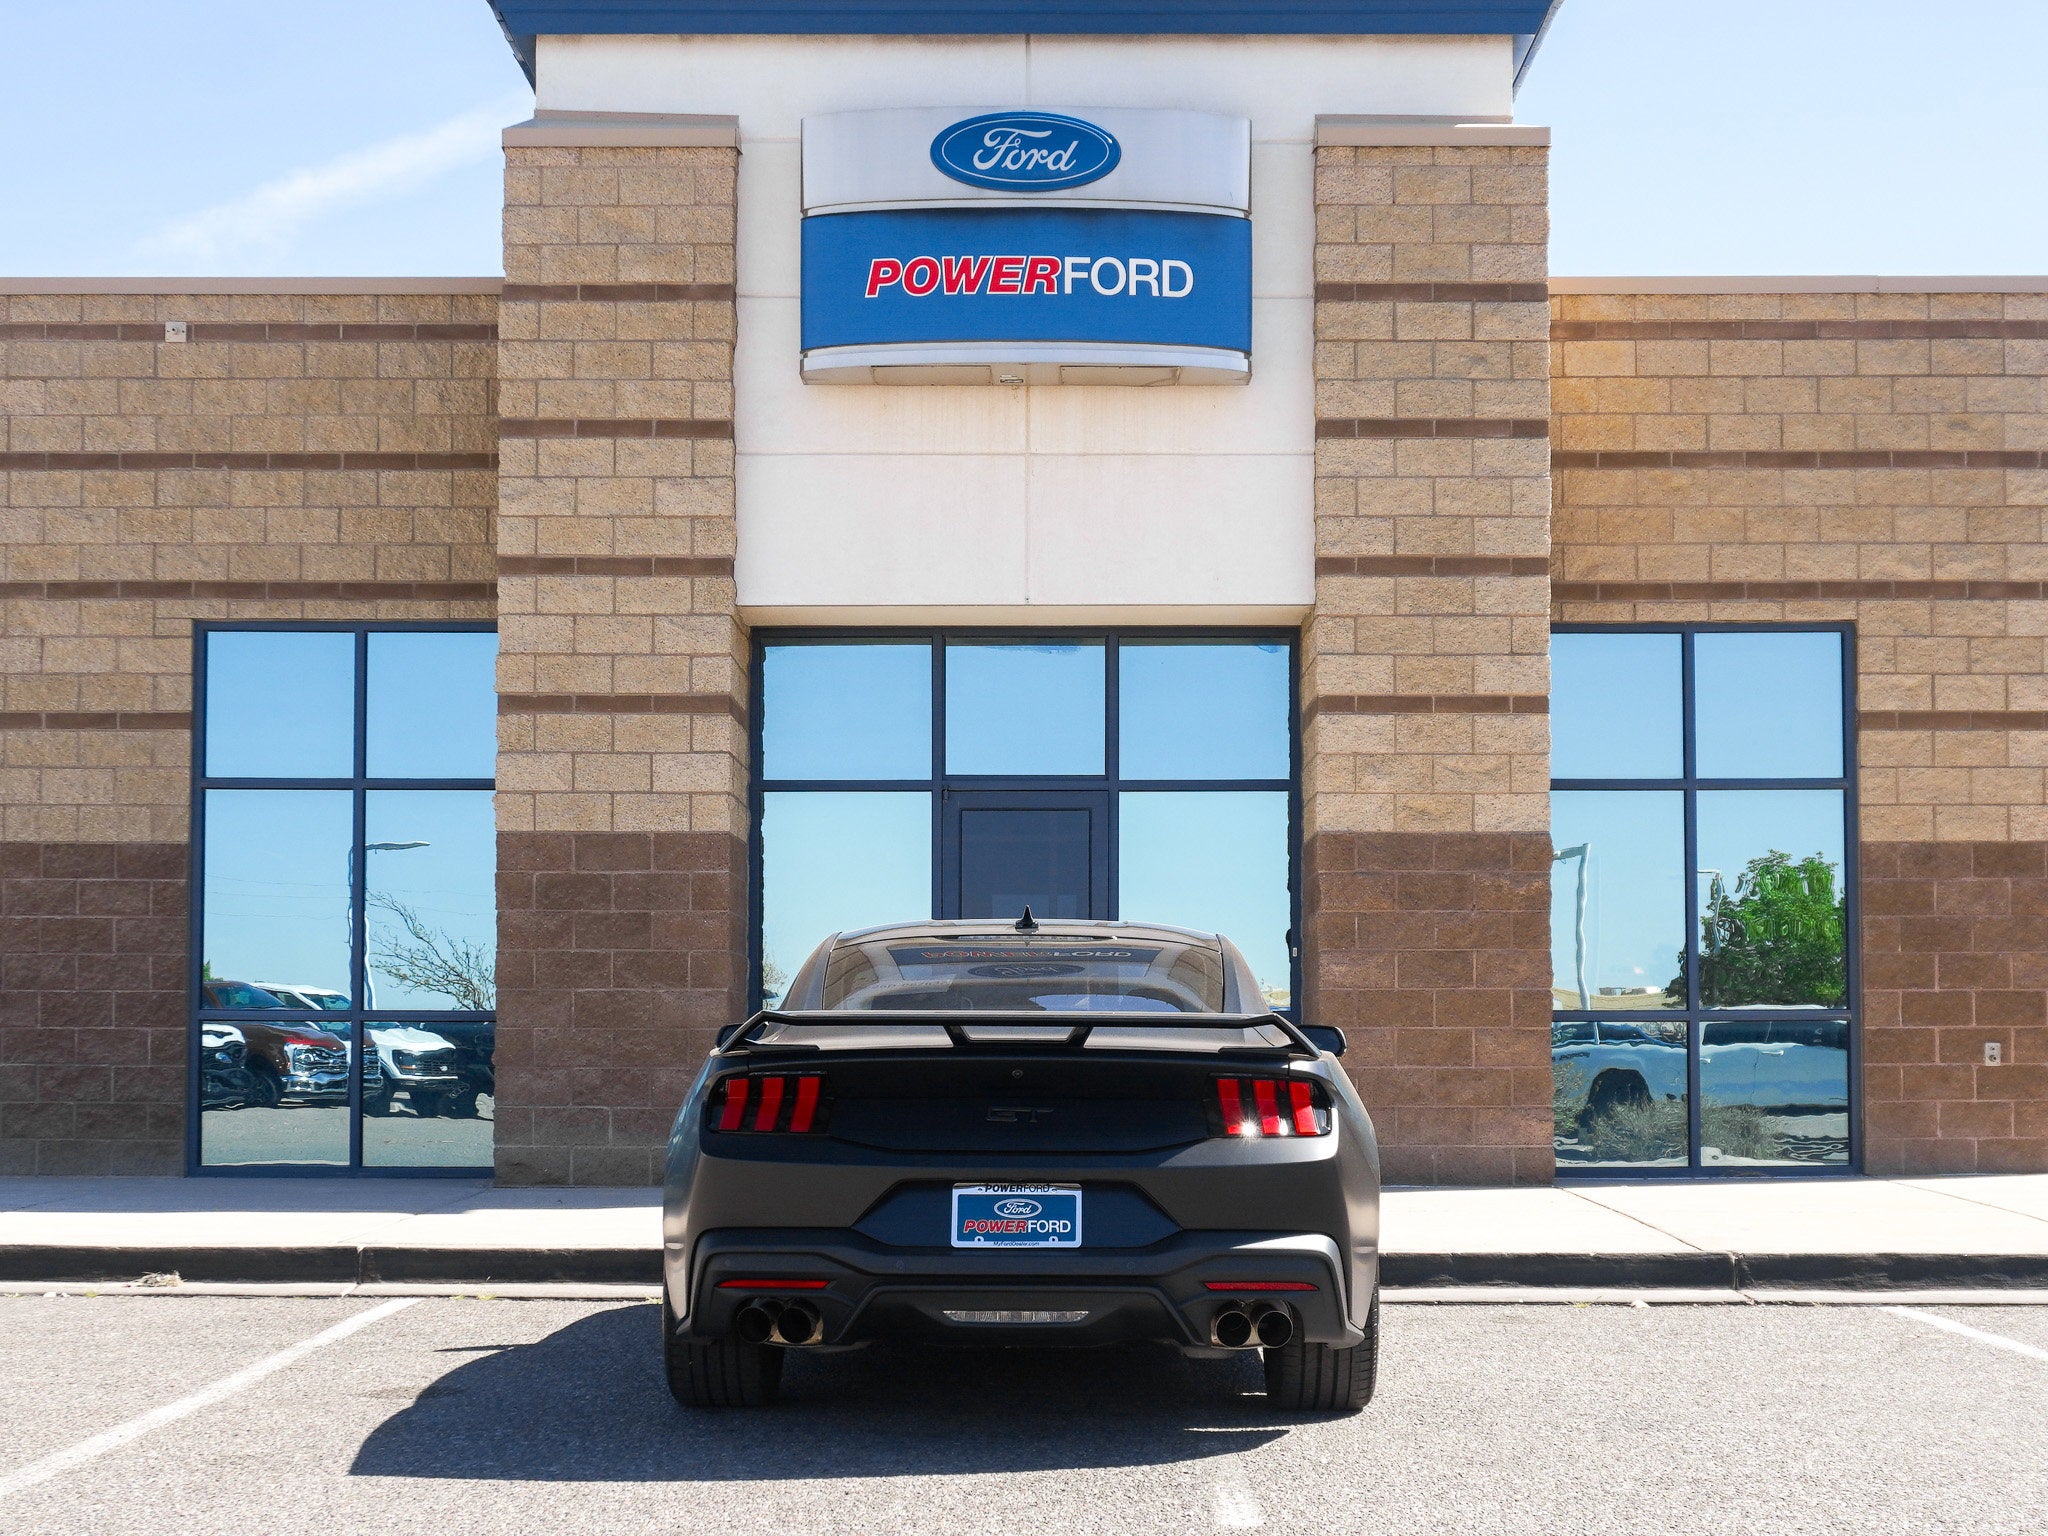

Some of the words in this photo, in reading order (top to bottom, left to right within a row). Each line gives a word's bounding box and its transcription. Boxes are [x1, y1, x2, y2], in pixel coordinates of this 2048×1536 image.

[972, 127, 1078, 172] Ford
[864, 255, 1195, 298] POWERFORD
[985, 1106, 1055, 1123] GT
[984, 1183, 1050, 1193] POWERFORD
[1003, 1202, 1032, 1214] Ford
[963, 1219, 1071, 1233] POWERFORD
